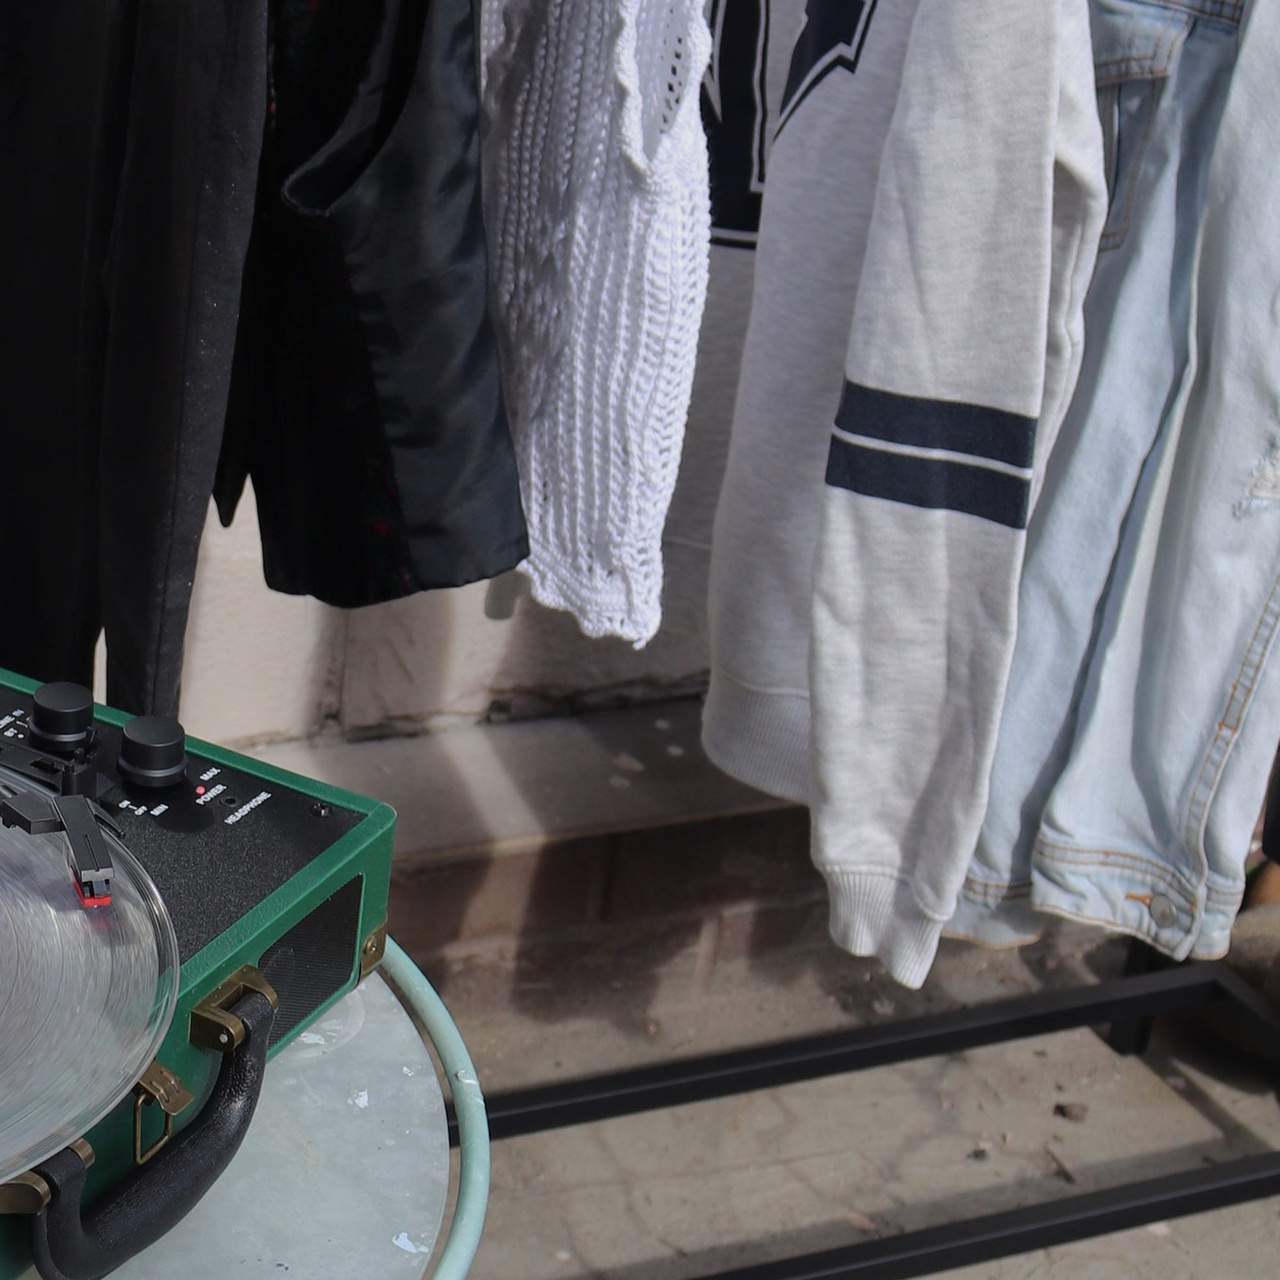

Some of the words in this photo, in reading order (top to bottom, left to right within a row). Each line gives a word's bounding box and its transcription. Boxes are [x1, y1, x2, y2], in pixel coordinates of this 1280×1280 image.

[12, 708, 25, 717] IN
[3, 727, 18, 737] BT
[200, 767, 221, 781] MAX
[195, 784, 228, 805] POWER
[118, 799, 131, 809] ON
[150, 803, 169, 817] MIN
[224, 791, 272, 825] HEADPHONE
[134, 805, 148, 816] OFF
